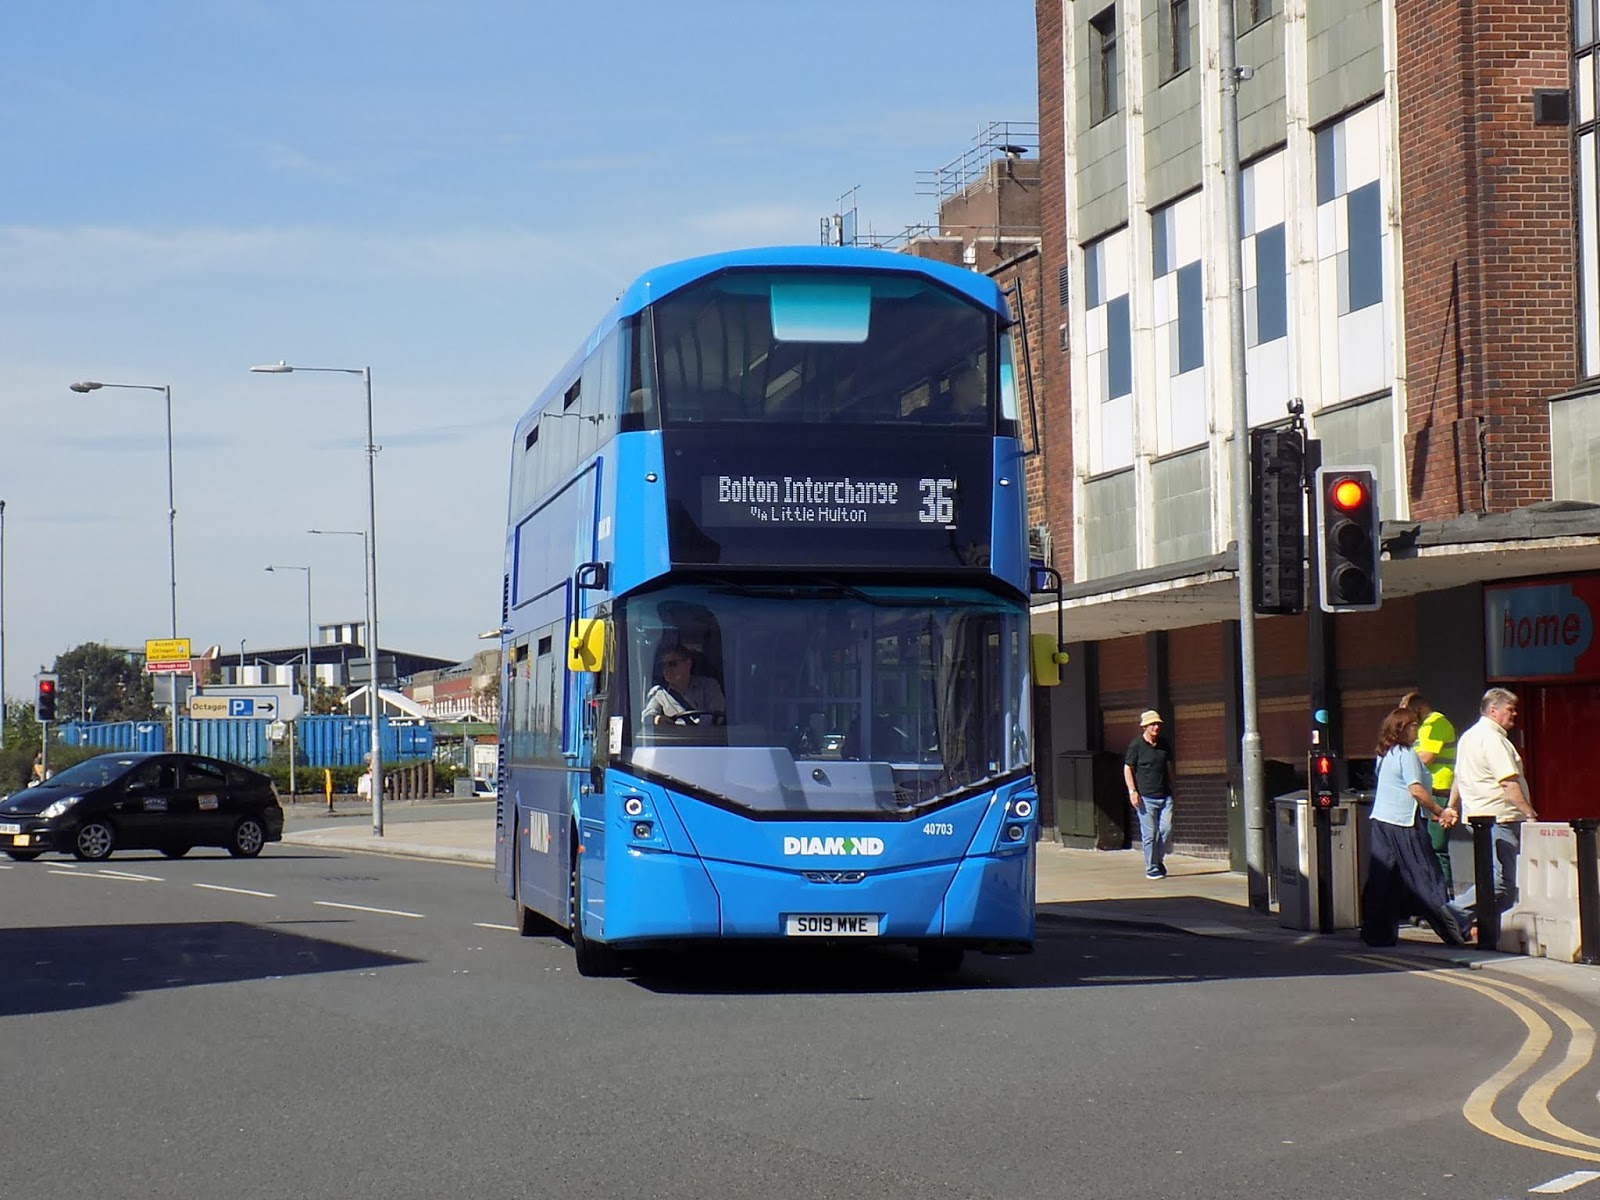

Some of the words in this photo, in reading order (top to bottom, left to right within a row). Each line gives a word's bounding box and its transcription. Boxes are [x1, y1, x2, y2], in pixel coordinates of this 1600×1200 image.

[718, 475, 779, 503] Bolton
[783, 476, 899, 504] Interchange
[918, 478, 954, 523] 36
[771, 506, 815, 522] Little
[817, 506, 868, 522] Hulton
[1502, 608, 1581, 649] home
[192, 703, 227, 712] Octagon
[232, 700, 245, 716] P
[922, 823, 954, 836] 40703
[783, 836, 885, 856] DIAMOND
[797, 916, 833, 933] SO19
[837, 916, 869, 933] MWE
